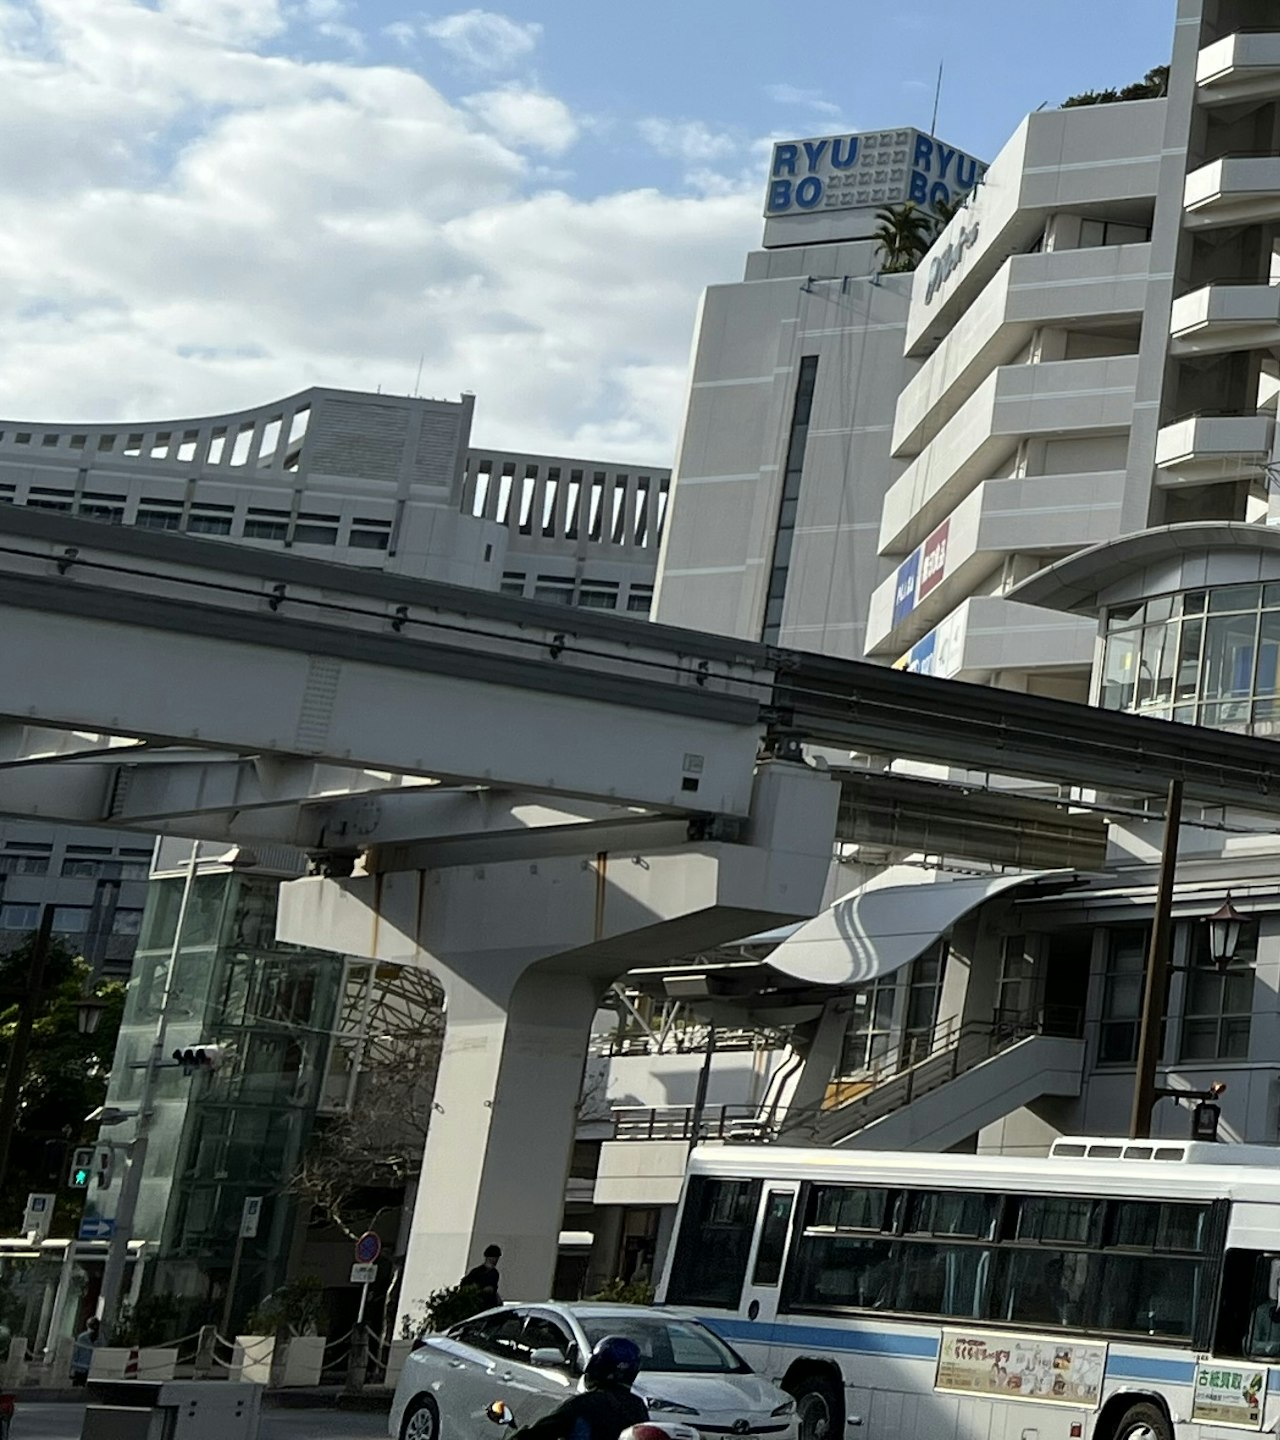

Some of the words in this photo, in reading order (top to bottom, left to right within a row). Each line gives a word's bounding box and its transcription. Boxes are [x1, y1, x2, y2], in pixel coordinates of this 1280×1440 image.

[772, 137, 859, 177] RYU
[914, 134, 977, 190] RYU
[769, 176, 823, 212] BO
[909, 169, 950, 209] BO
[1198, 1369, 1243, 1390] 古紙買取
